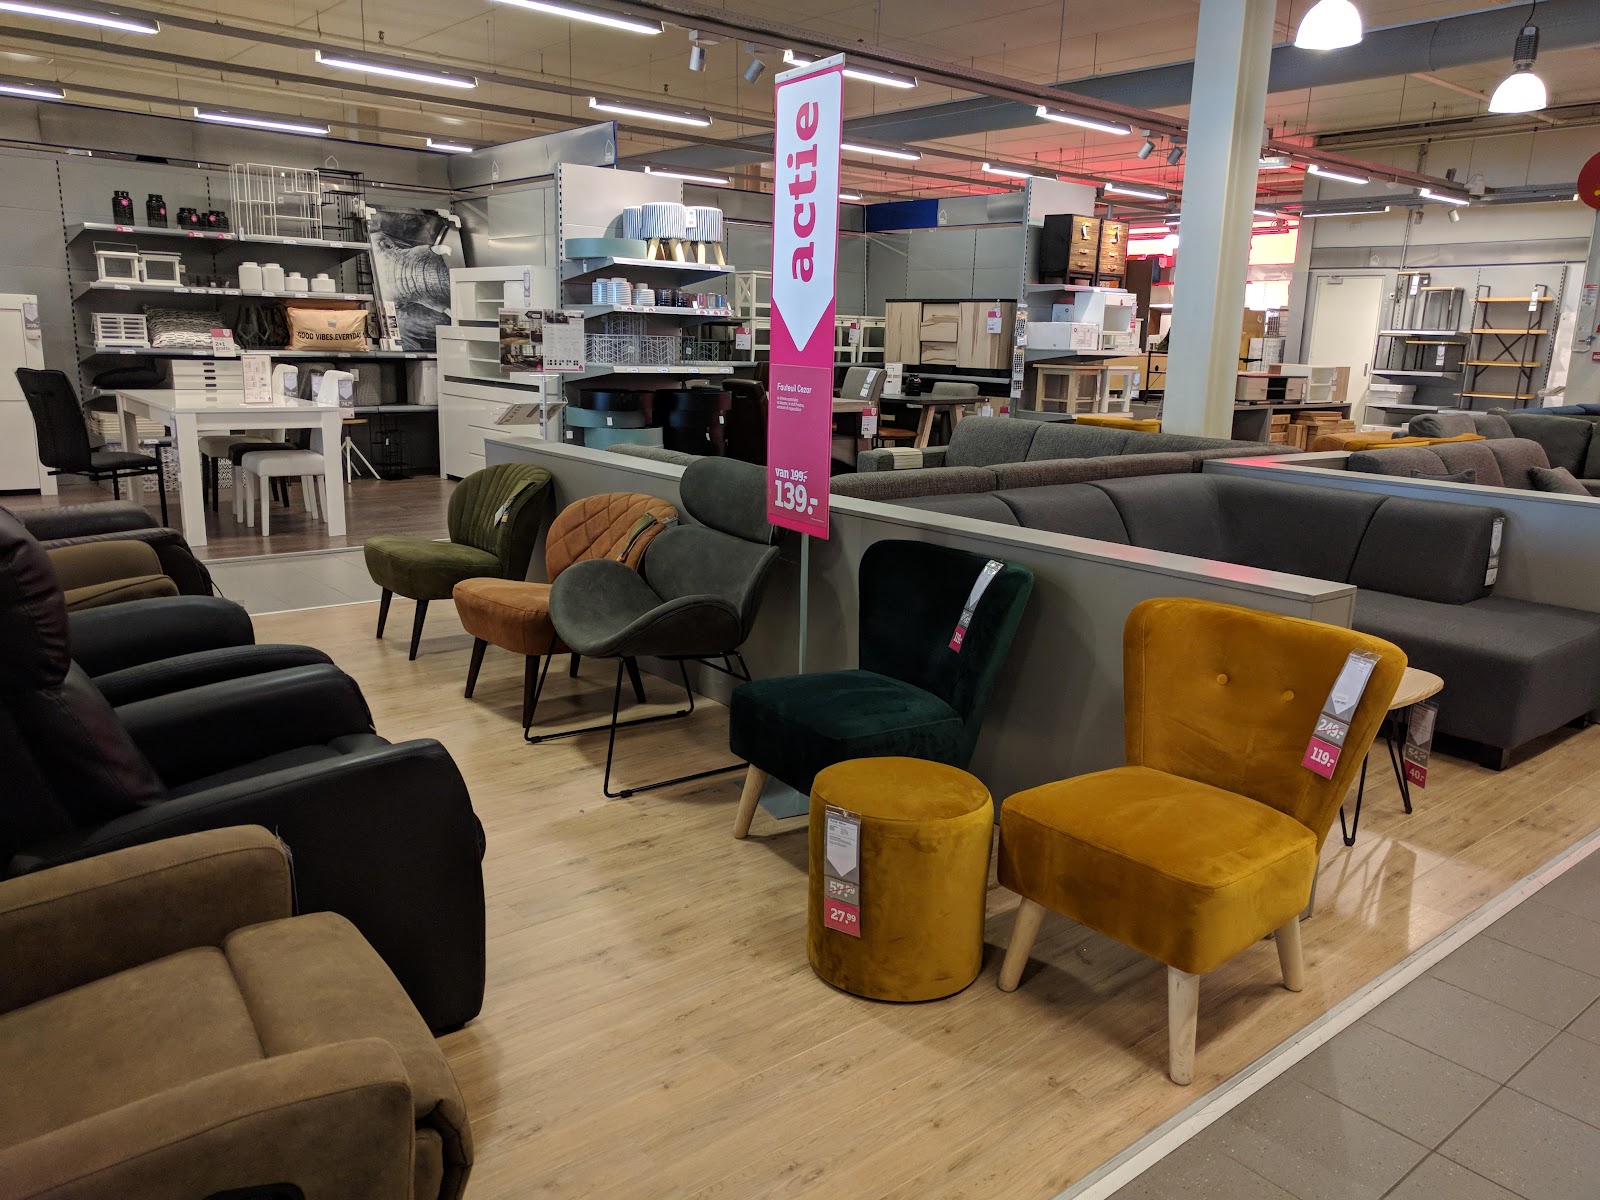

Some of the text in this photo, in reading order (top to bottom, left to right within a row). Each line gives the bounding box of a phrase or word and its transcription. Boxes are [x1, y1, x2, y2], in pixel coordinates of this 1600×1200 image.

[787, 101, 819, 283] actie
[297, 331, 314, 340] GOOD
[776, 382, 797, 393] Fauteuil
[774, 467, 789, 479] van
[774, 479, 818, 516] 139.-
[1316, 718, 1344, 740] 249.-
[1310, 746, 1335, 768] 119.-
[829, 880, 856, 898] 57.99
[830, 907, 857, 925] 27.99
